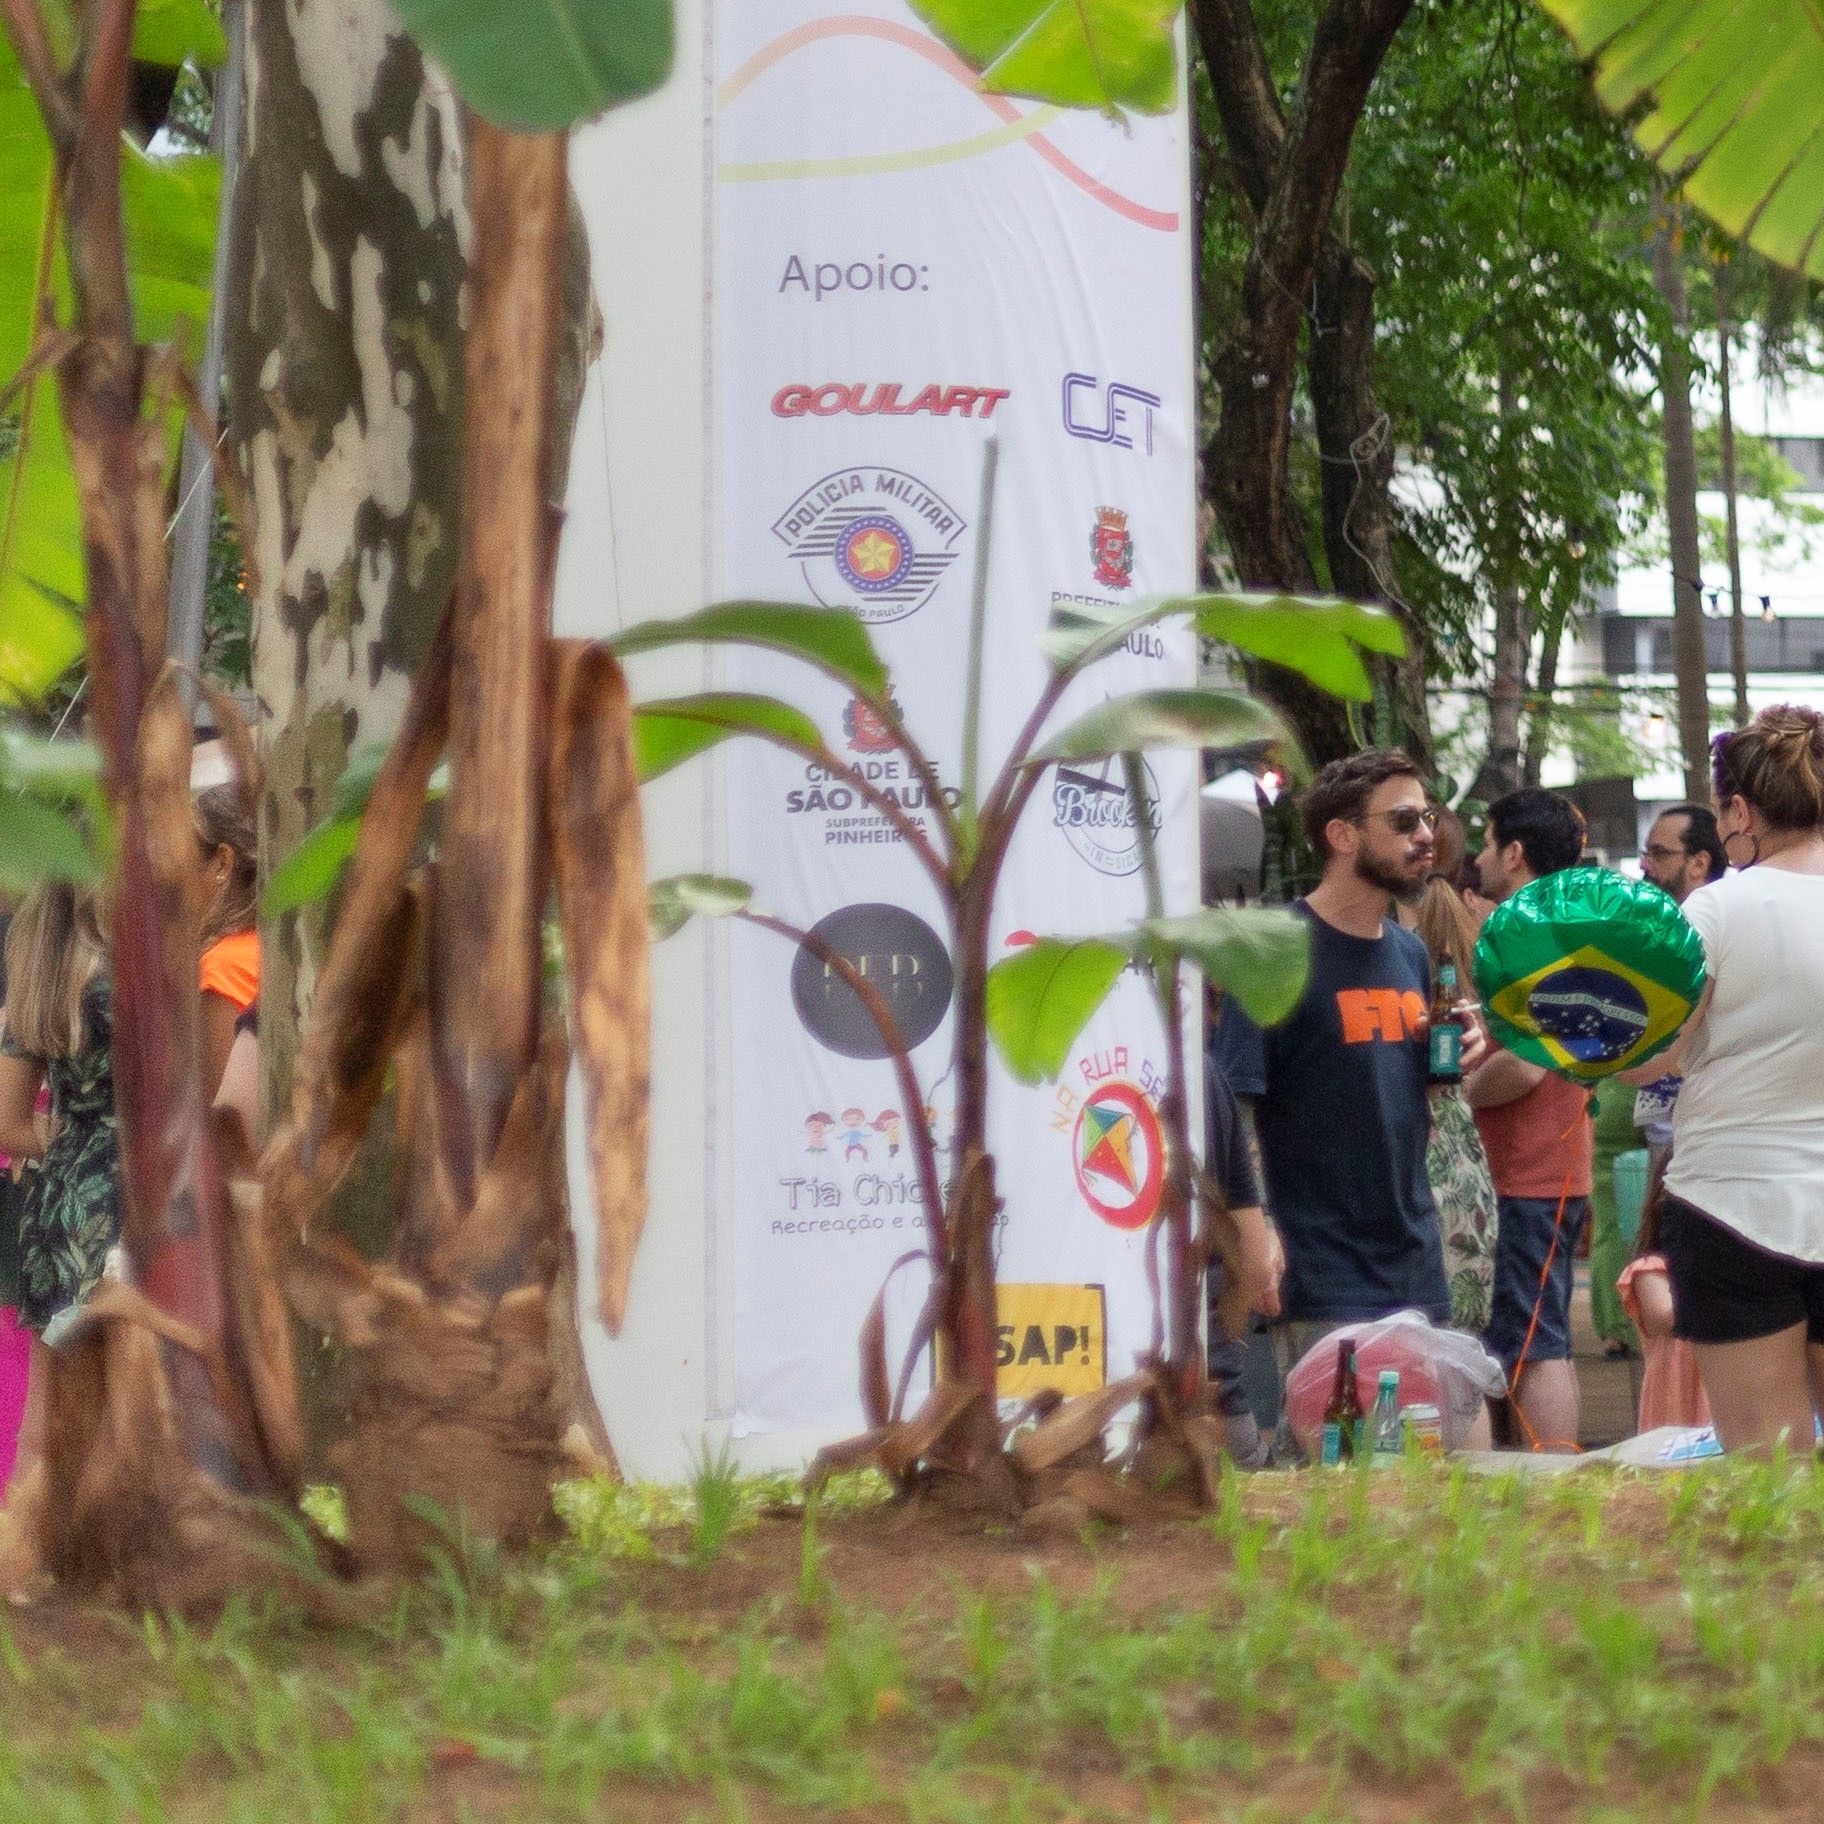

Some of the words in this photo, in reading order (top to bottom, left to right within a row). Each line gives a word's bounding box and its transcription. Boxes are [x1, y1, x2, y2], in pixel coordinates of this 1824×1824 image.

[778, 254, 930, 302] Apoio:
[771, 382, 1011, 419] GOULART
[875, 474, 955, 535] MILITAR
[869, 604, 905, 619] PAULO
[786, 784, 853, 813] SÃO
[1079, 1046, 1129, 1085] RUA
[779, 1177, 842, 1210] Tia
[771, 1214, 885, 1235] Recreação
[892, 1215, 904, 1229] e
